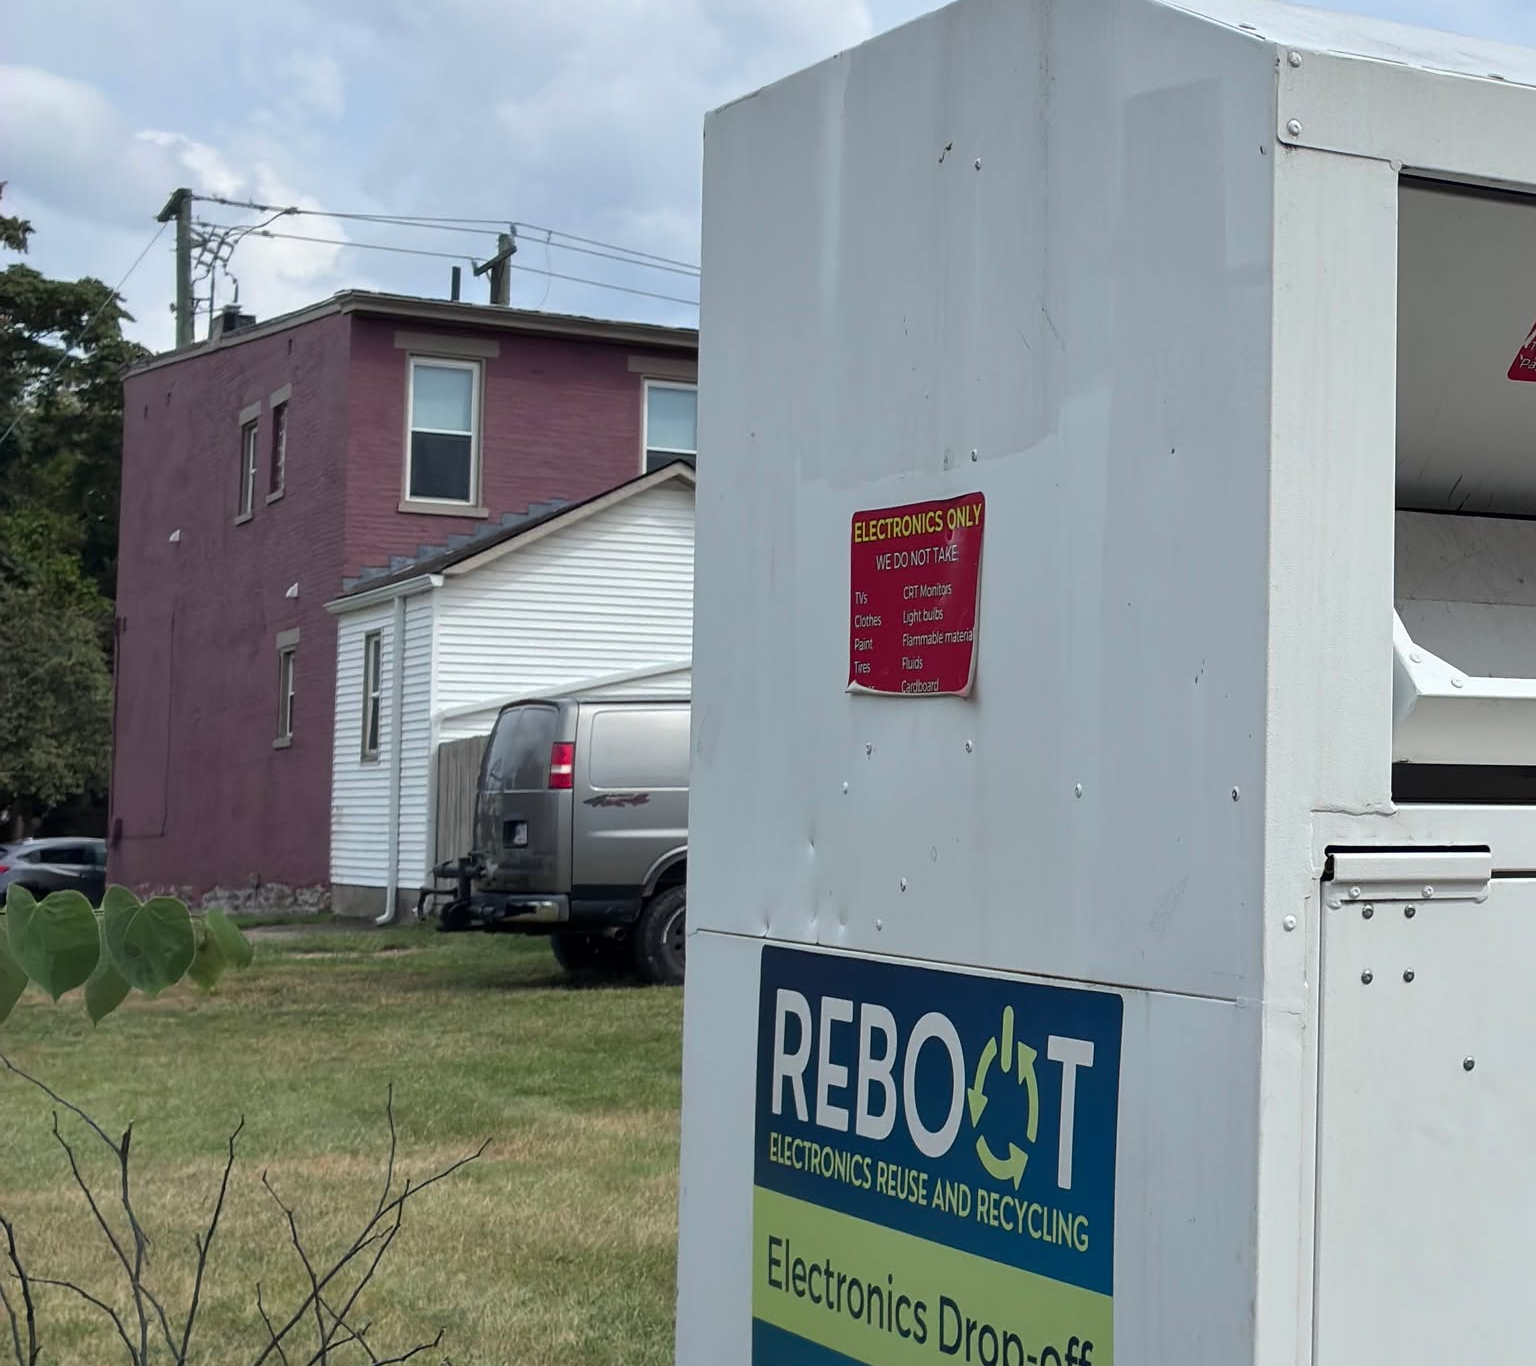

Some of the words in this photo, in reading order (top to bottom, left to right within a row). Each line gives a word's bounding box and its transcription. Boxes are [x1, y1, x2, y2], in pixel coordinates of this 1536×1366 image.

[854, 510, 943, 543] ELECTRONICS
[946, 503, 982, 531] ONLY
[876, 554, 892, 571] WE
[894, 551, 908, 569] DO
[910, 548, 931, 567] NOT
[855, 591, 868, 604] TVs
[903, 585, 919, 600] CRT
[920, 582, 952, 598] Monitors
[854, 614, 881, 628] Clothes
[903, 609, 922, 626] Light
[923, 607, 943, 621] bulbs
[854, 637, 873, 651] Paint
[902, 630, 943, 647] Flammable
[854, 660, 871, 674] Tires
[902, 656, 923, 670] Fluids
[901, 679, 939, 693] Cardboard
[769, 1131, 873, 1192] ELECTRONICS
[876, 1162, 928, 1210] REUSE
[932, 1180, 971, 1220] AND
[977, 1188, 1089, 1253] RECYCLING
[767, 1235, 928, 1345] Electronics
